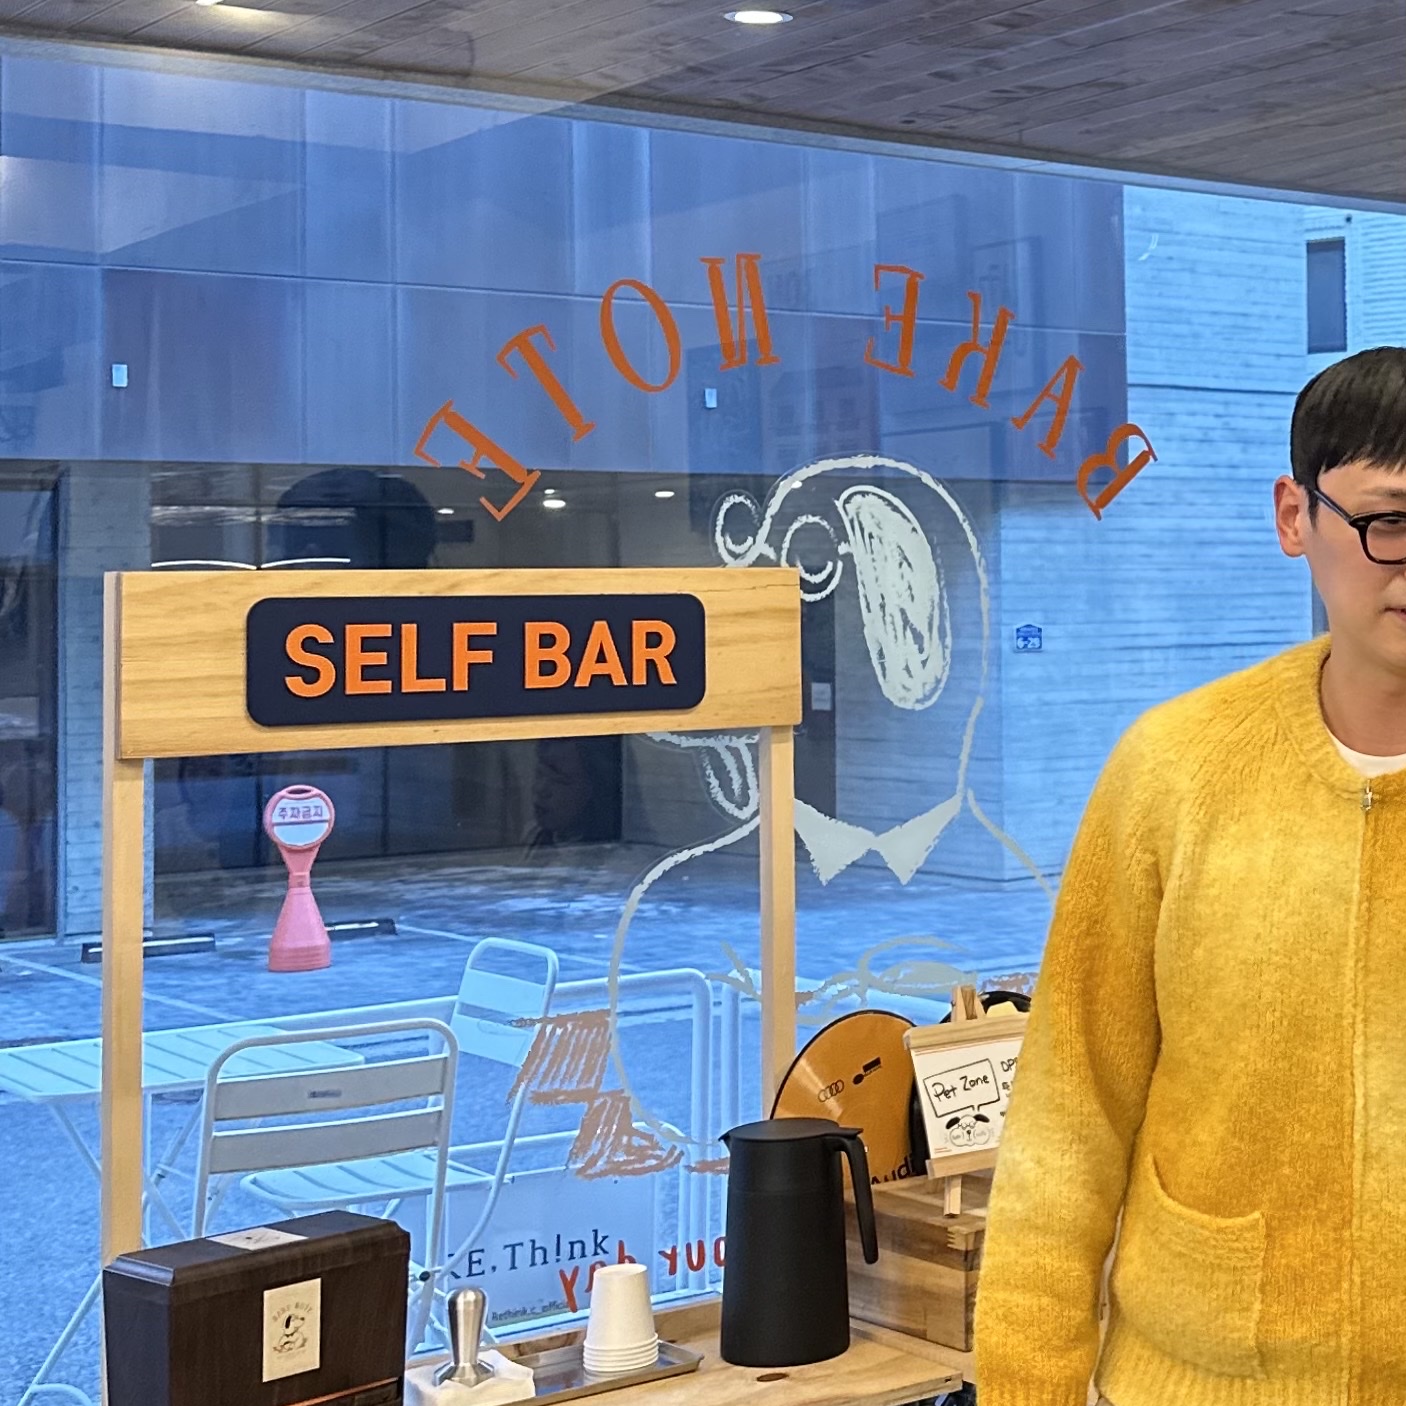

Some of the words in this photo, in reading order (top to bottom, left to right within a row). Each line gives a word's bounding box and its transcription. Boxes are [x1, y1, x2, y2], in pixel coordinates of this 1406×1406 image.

[284, 622, 497, 698] SELF
[524, 620, 677, 690] BAR
[932, 1081, 957, 1102] Pet
[960, 1074, 990, 1091] Zone
